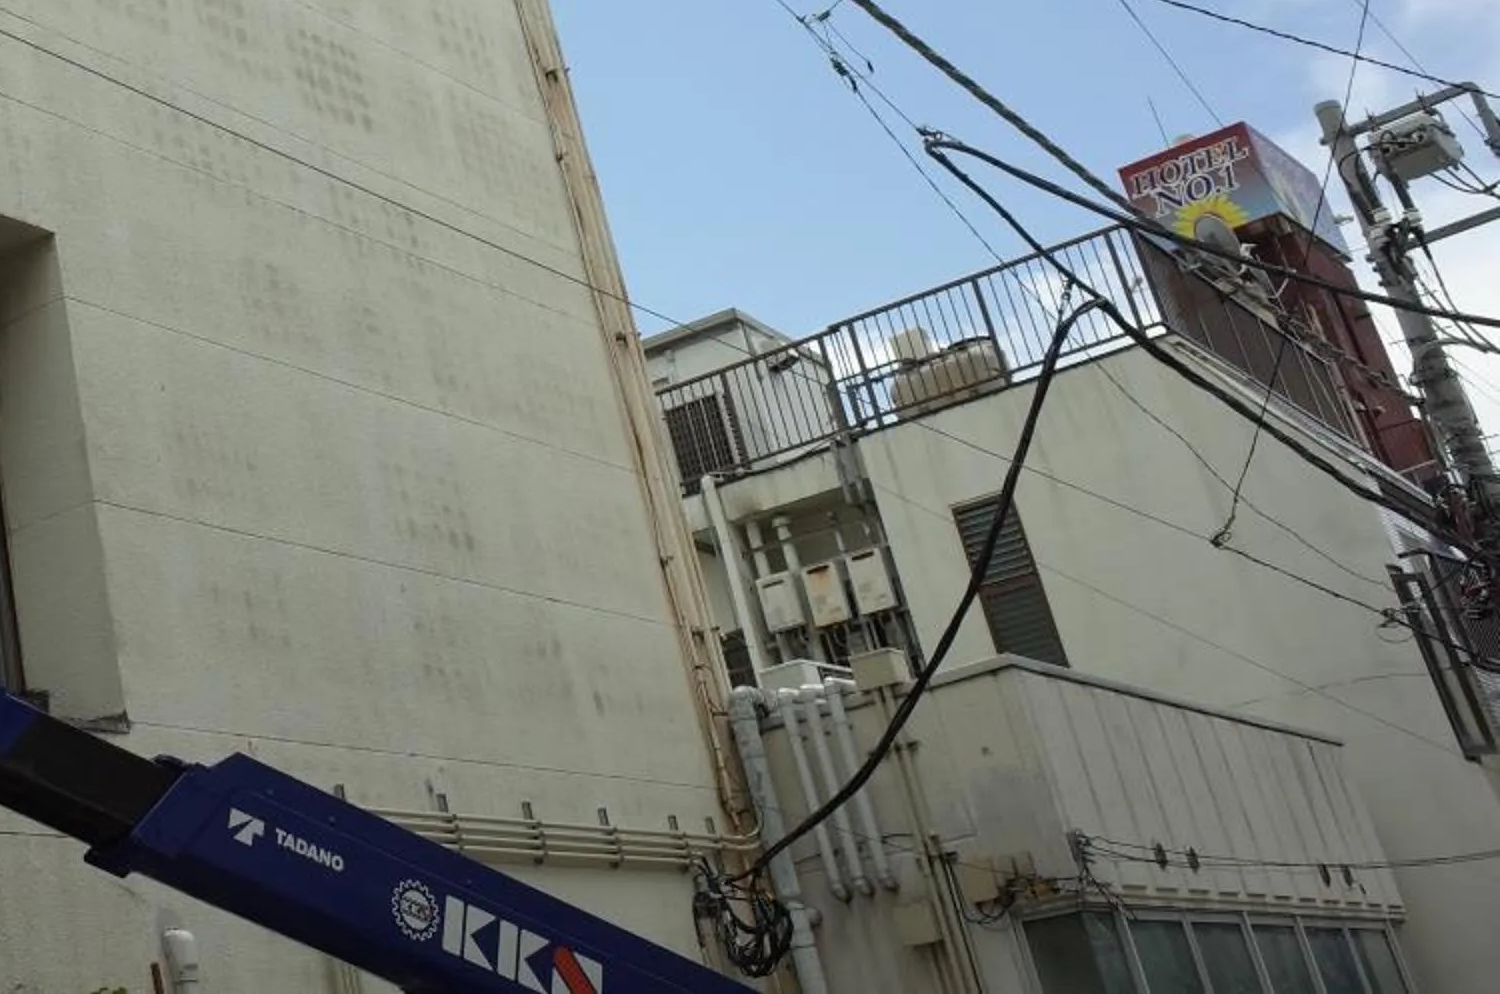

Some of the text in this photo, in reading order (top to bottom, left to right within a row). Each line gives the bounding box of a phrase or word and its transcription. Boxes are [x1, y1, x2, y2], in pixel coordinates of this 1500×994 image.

[1130, 135, 1250, 200] HOTEL
[1153, 160, 1240, 219] NO.1
[275, 827, 345, 873] TADANO
